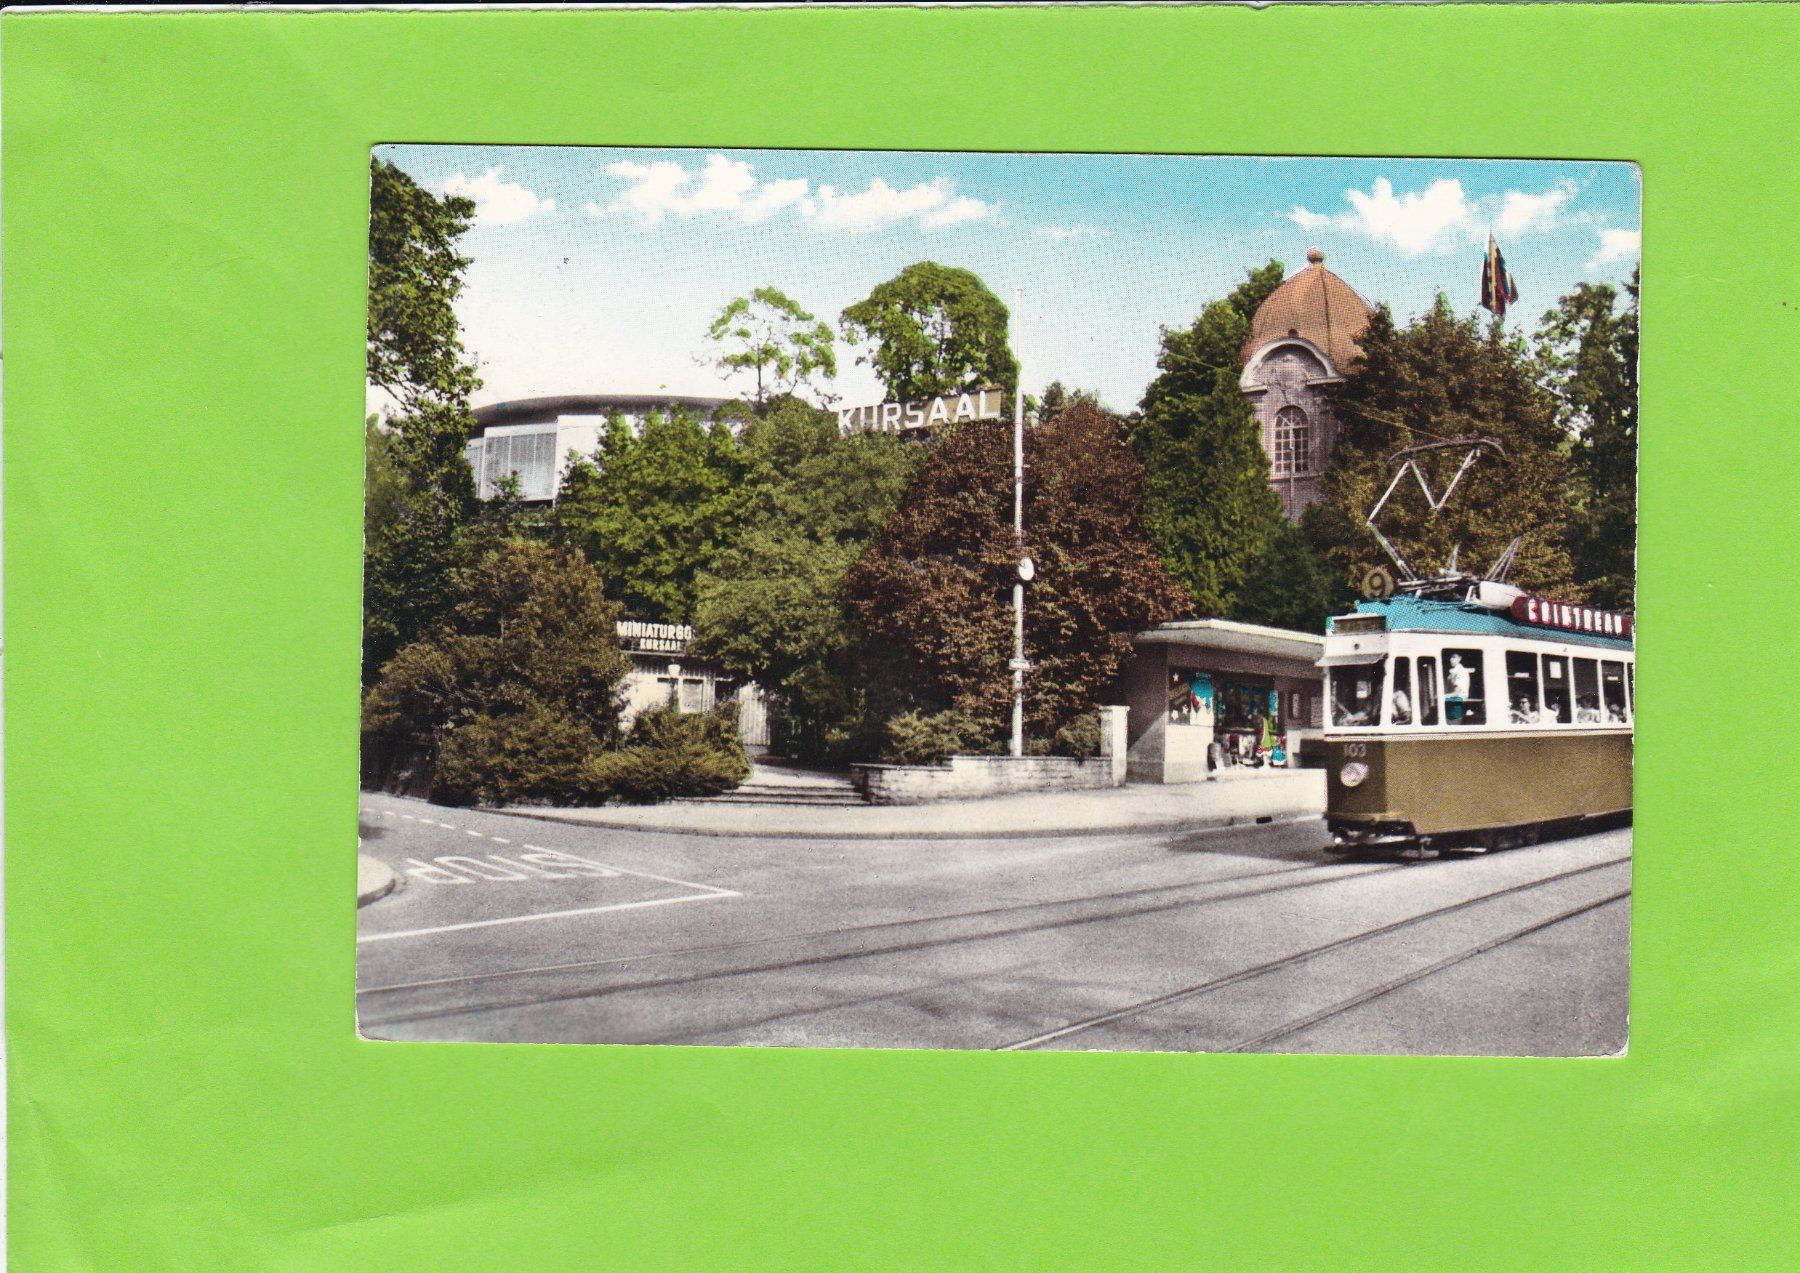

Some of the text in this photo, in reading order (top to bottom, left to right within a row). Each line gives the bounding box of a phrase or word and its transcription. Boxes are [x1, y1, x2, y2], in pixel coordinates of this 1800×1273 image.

[838, 390, 1001, 437] KURSAAL
[1368, 572, 1386, 597] 9
[1527, 599, 1624, 634] COINTREAU
[640, 638, 682, 652] KURSAAL
